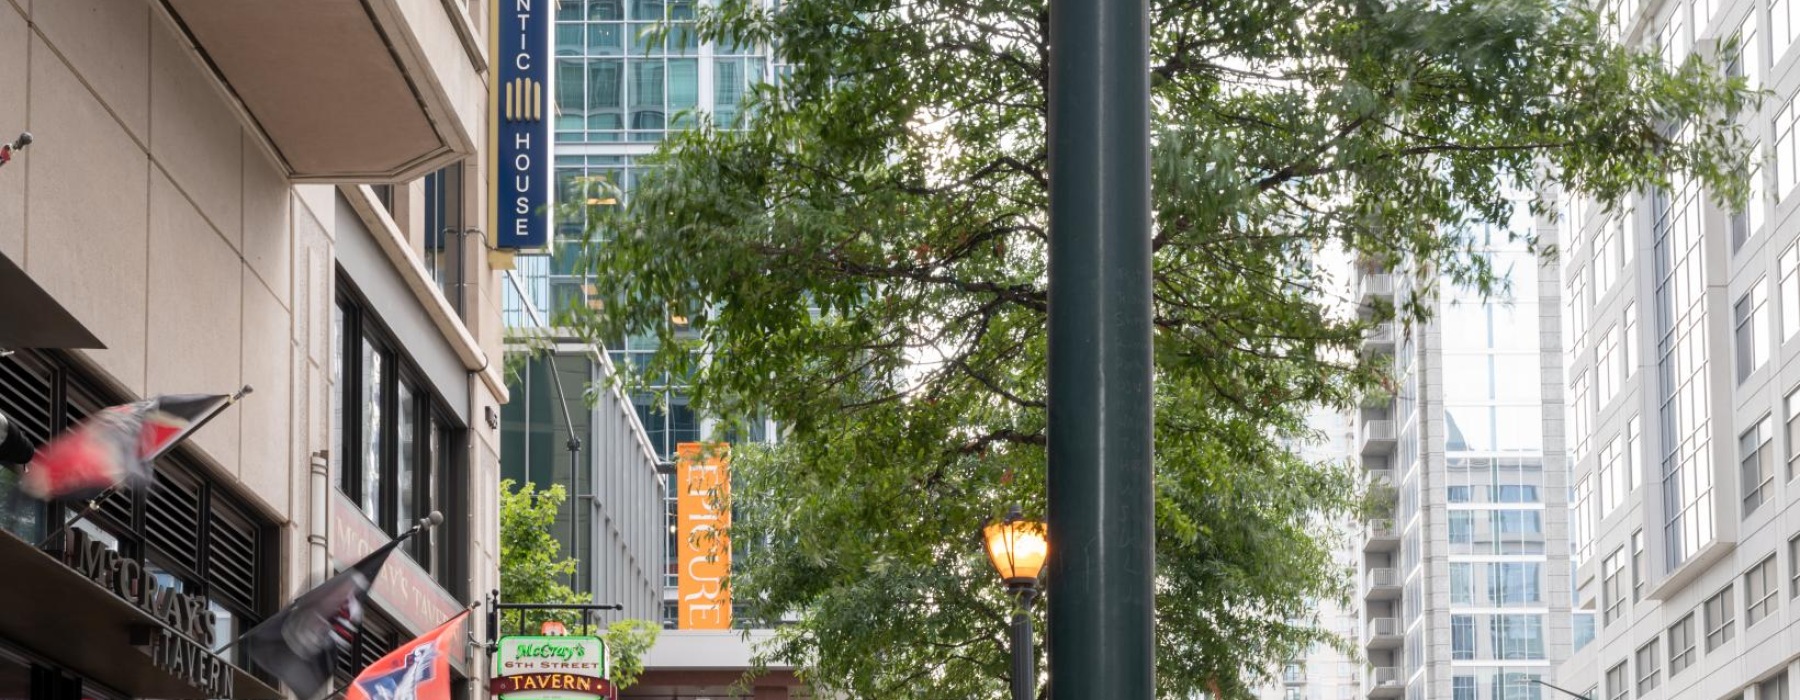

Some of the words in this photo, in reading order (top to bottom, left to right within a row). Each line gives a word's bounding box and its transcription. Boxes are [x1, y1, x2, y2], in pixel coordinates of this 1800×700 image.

[515, 132, 530, 236] HOUSE
[161, 628, 234, 699] TAVERN
[516, 643, 585, 660] McCray's
[509, 674, 591, 691] TAVERN
